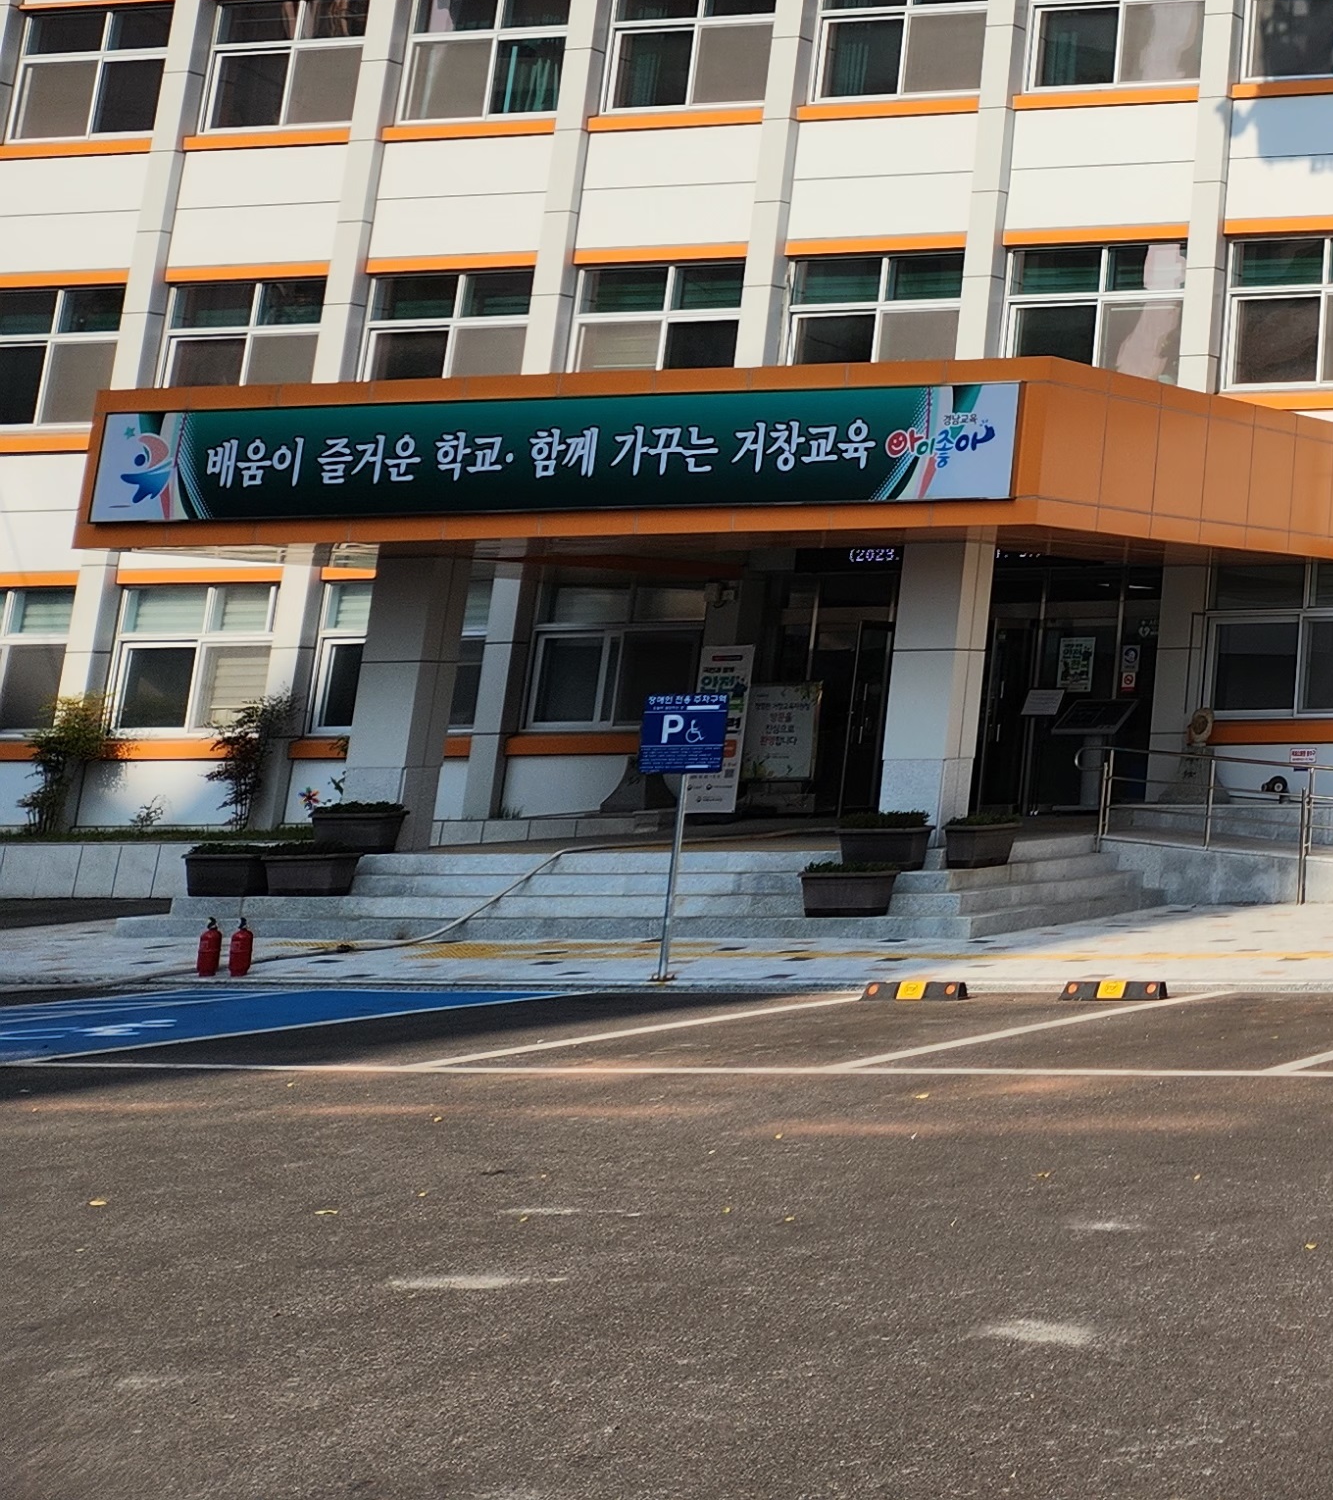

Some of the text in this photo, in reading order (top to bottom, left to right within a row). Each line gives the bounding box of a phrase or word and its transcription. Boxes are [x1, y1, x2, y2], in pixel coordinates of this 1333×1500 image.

[943, 414, 978, 426] 경남교육
[206, 436, 304, 488] 배움이
[317, 434, 421, 484] 즐거운
[530, 426, 598, 478] 함께
[611, 425, 719, 476] 가꾸는
[731, 419, 876, 473] 거창교육
[648, 694, 728, 705] 장애인 전용 주차구역
[661, 714, 684, 744] P
